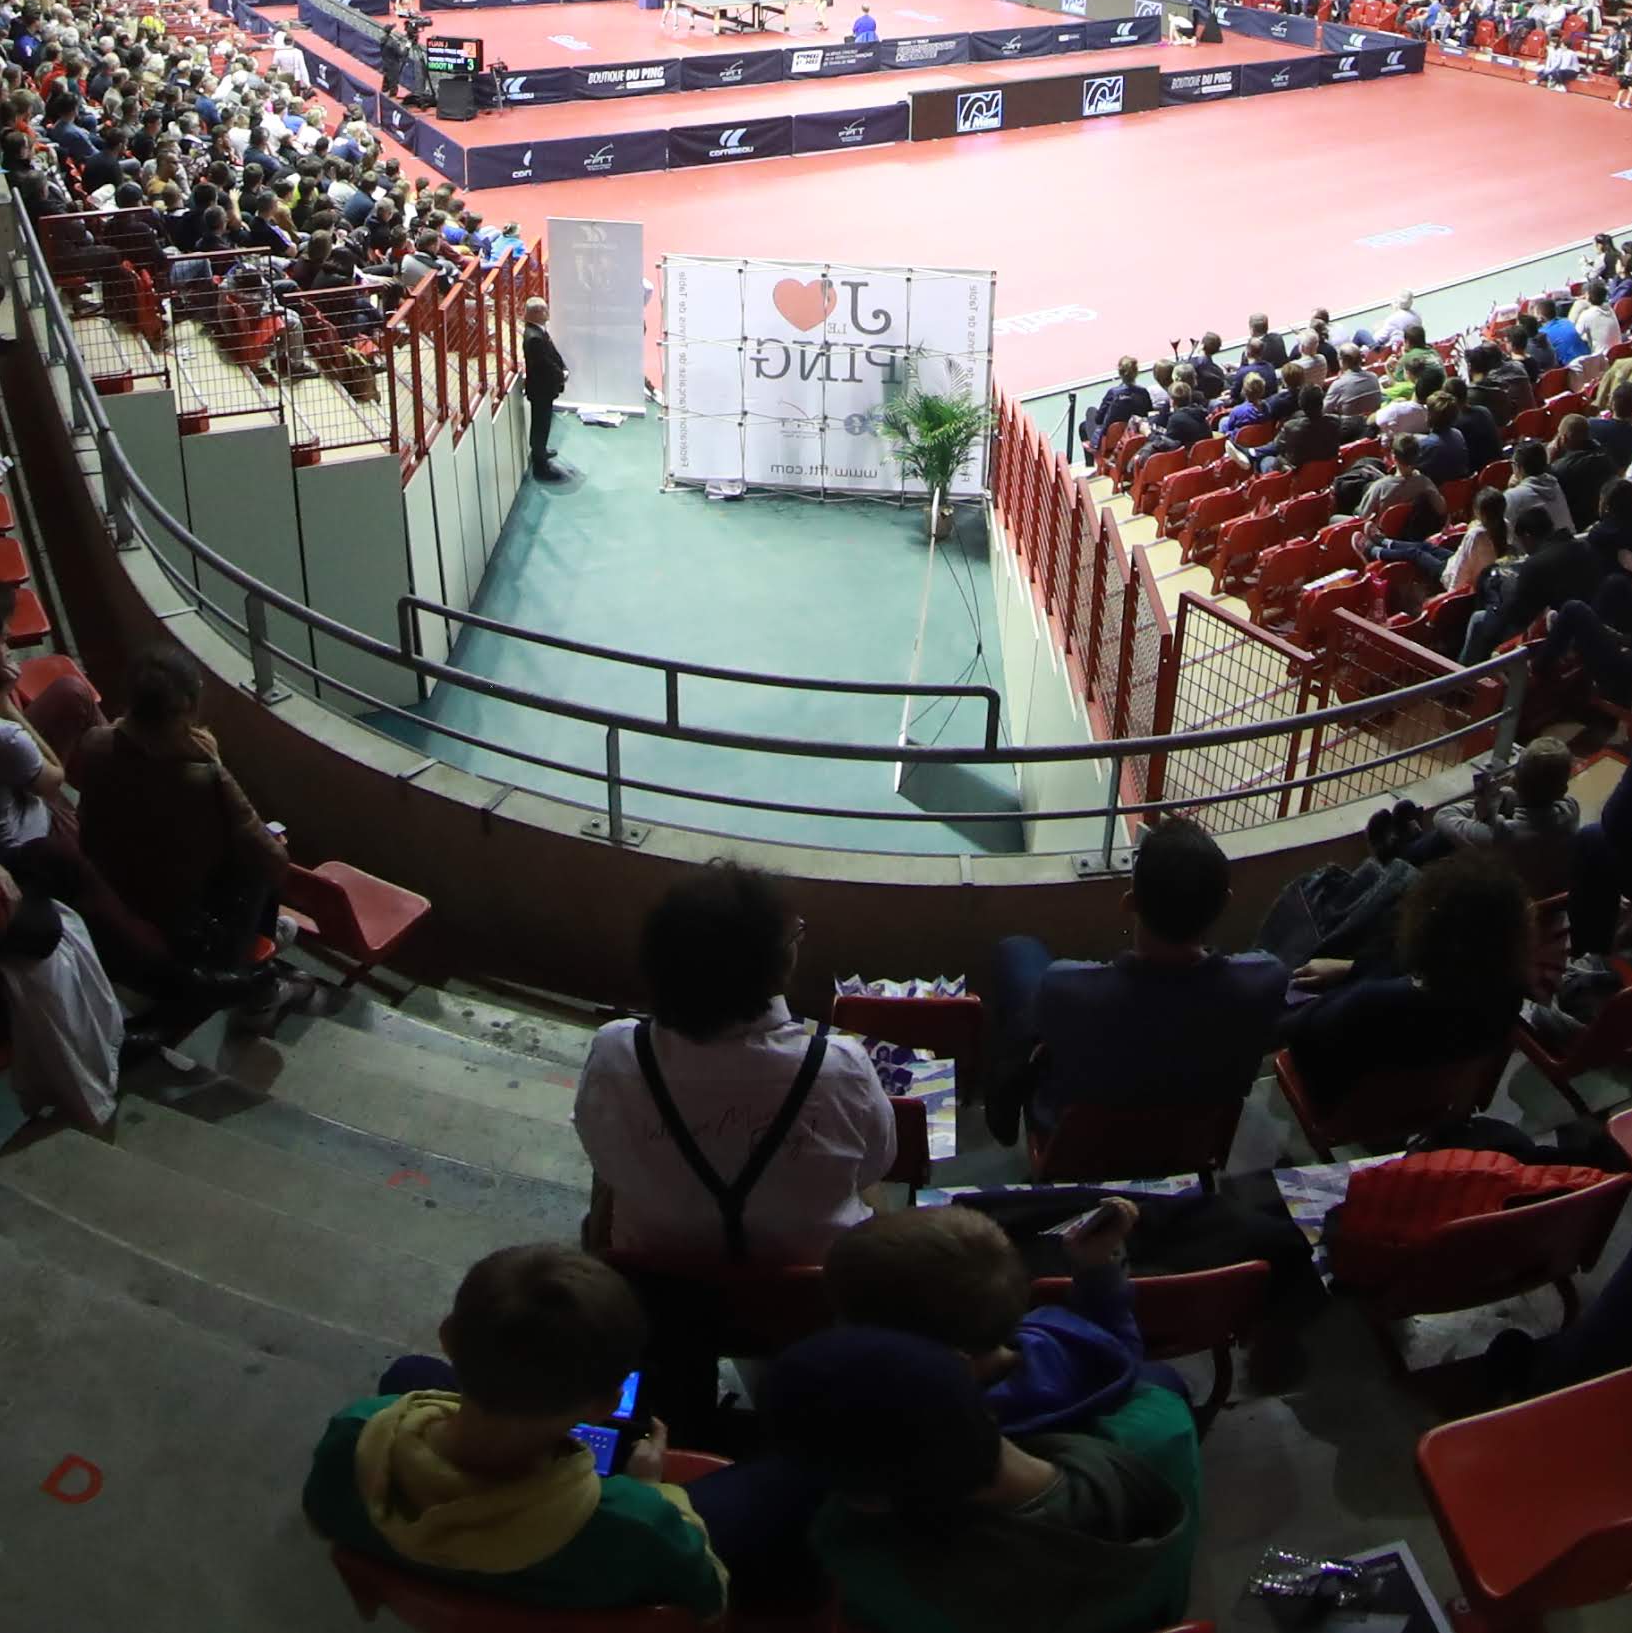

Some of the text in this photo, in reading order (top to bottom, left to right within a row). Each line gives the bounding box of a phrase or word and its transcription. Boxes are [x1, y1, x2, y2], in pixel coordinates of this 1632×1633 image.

[467, 58, 474, 70] 3
[587, 66, 664, 84] BOUTIQUE DU PING
[1201, 74, 1213, 85] DU
[1214, 71, 1232, 83] PING
[41, 1454, 102, 1504] D
